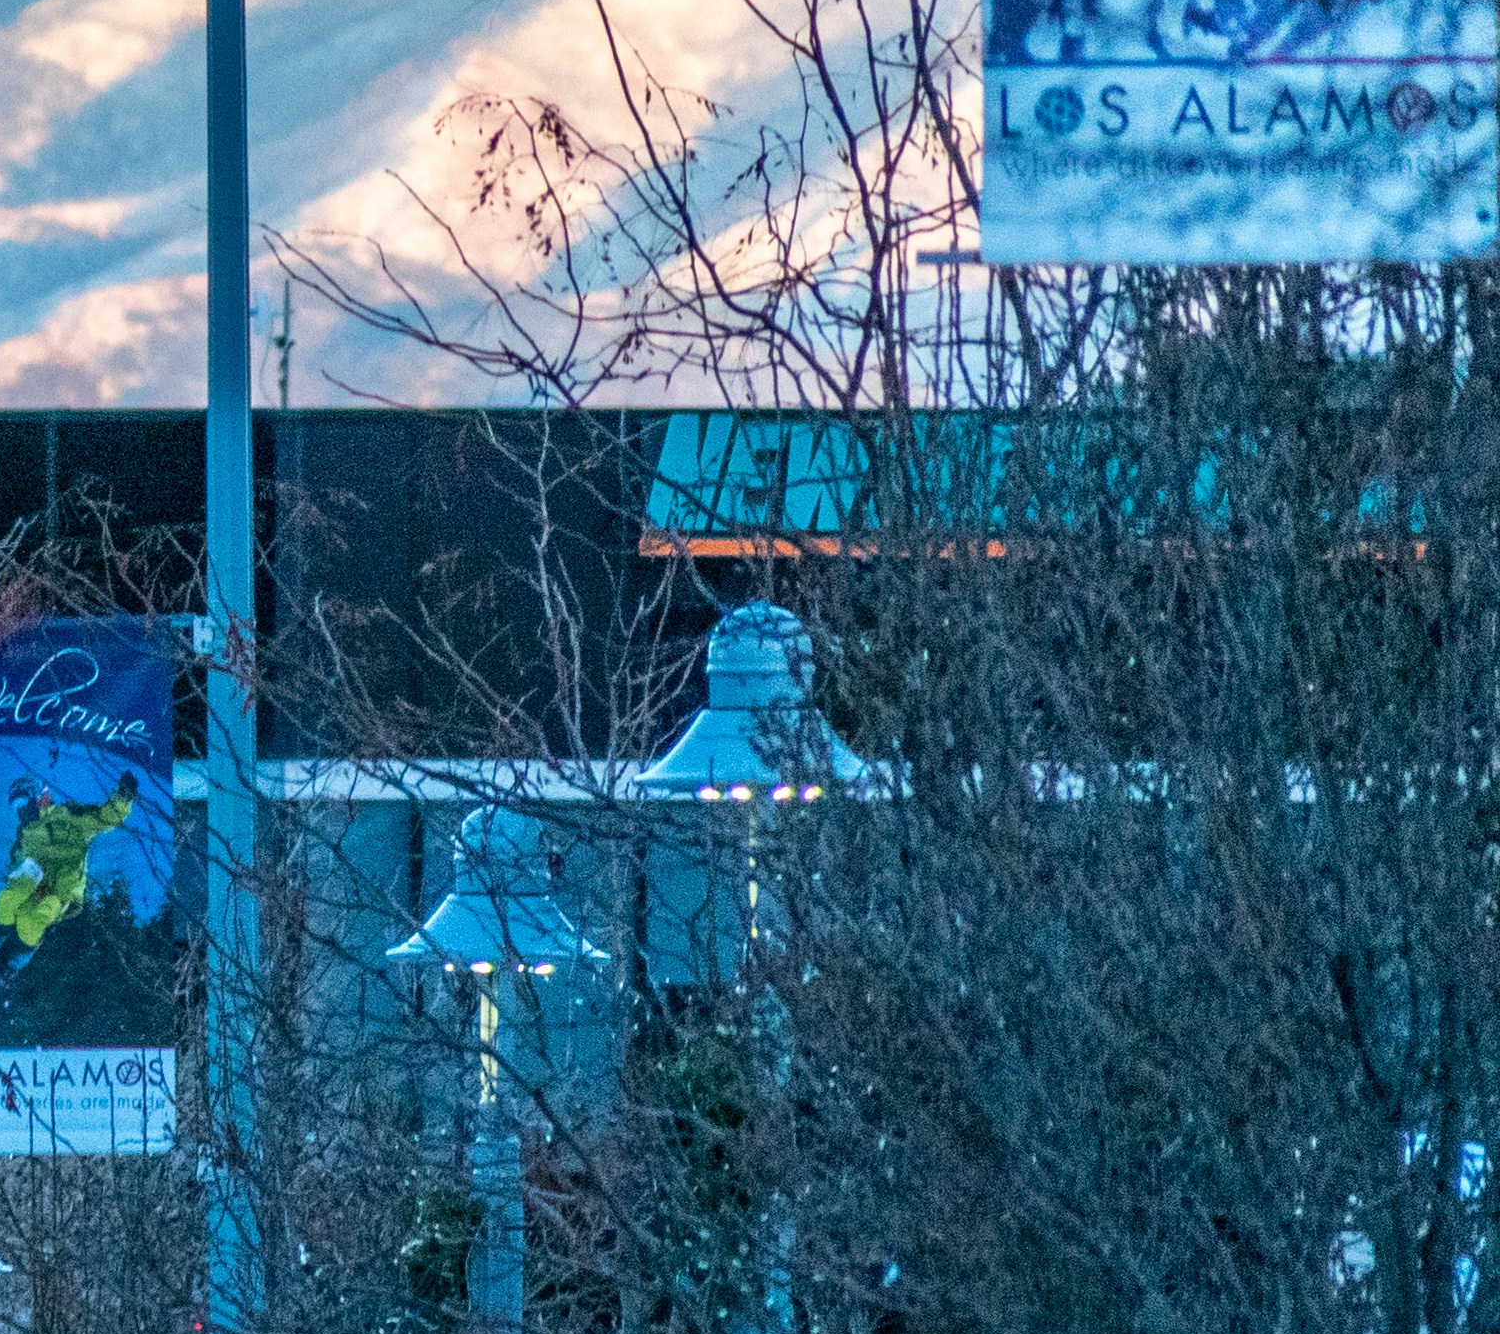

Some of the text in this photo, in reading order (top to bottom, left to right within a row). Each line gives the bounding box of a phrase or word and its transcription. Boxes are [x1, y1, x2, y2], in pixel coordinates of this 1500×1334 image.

[1000, 82, 1479, 139] LOS ALAMOS
[2, 1057, 165, 1088] ALAMOS
